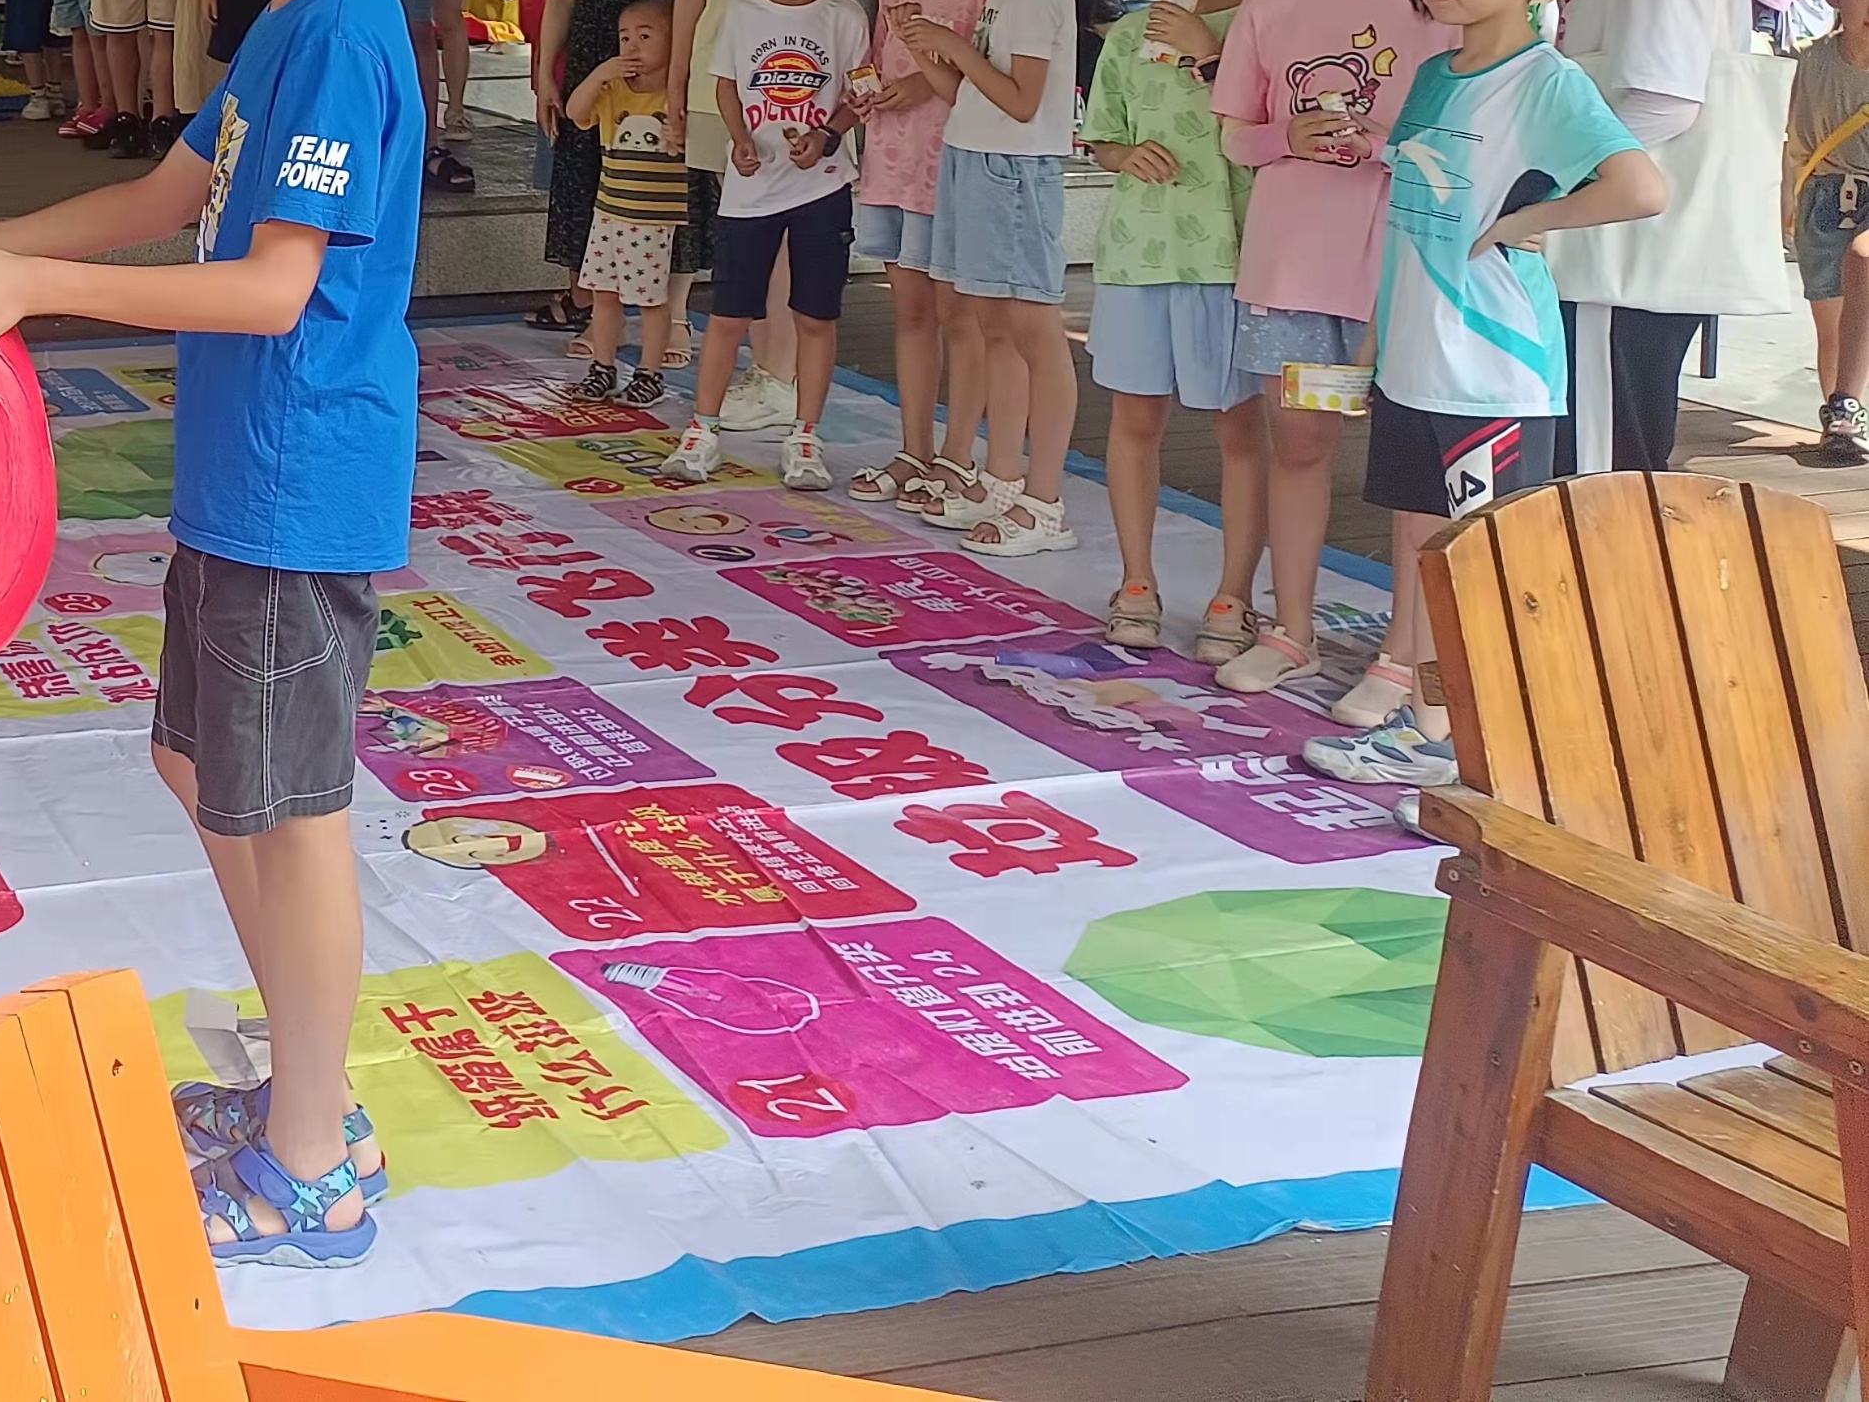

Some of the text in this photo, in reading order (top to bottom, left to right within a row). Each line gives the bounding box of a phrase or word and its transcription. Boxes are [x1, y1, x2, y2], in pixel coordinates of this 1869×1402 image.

[750, 35, 831, 67] BORN IN TEXAS
[754, 71, 825, 89] Dickies
[745, 100, 828, 131] DICKIES
[288, 134, 351, 167] TEAM
[274, 161, 351, 197] POWER
[694, 543, 750, 561] 2
[408, 765, 472, 797] 23
[566, 894, 645, 930] 22
[911, 948, 1104, 1059] 前进到 24
[383, 1000, 563, 1130] 纸箱属于
[466, 988, 652, 1123] 什么垃圾
[736, 1076, 842, 1123] 21
